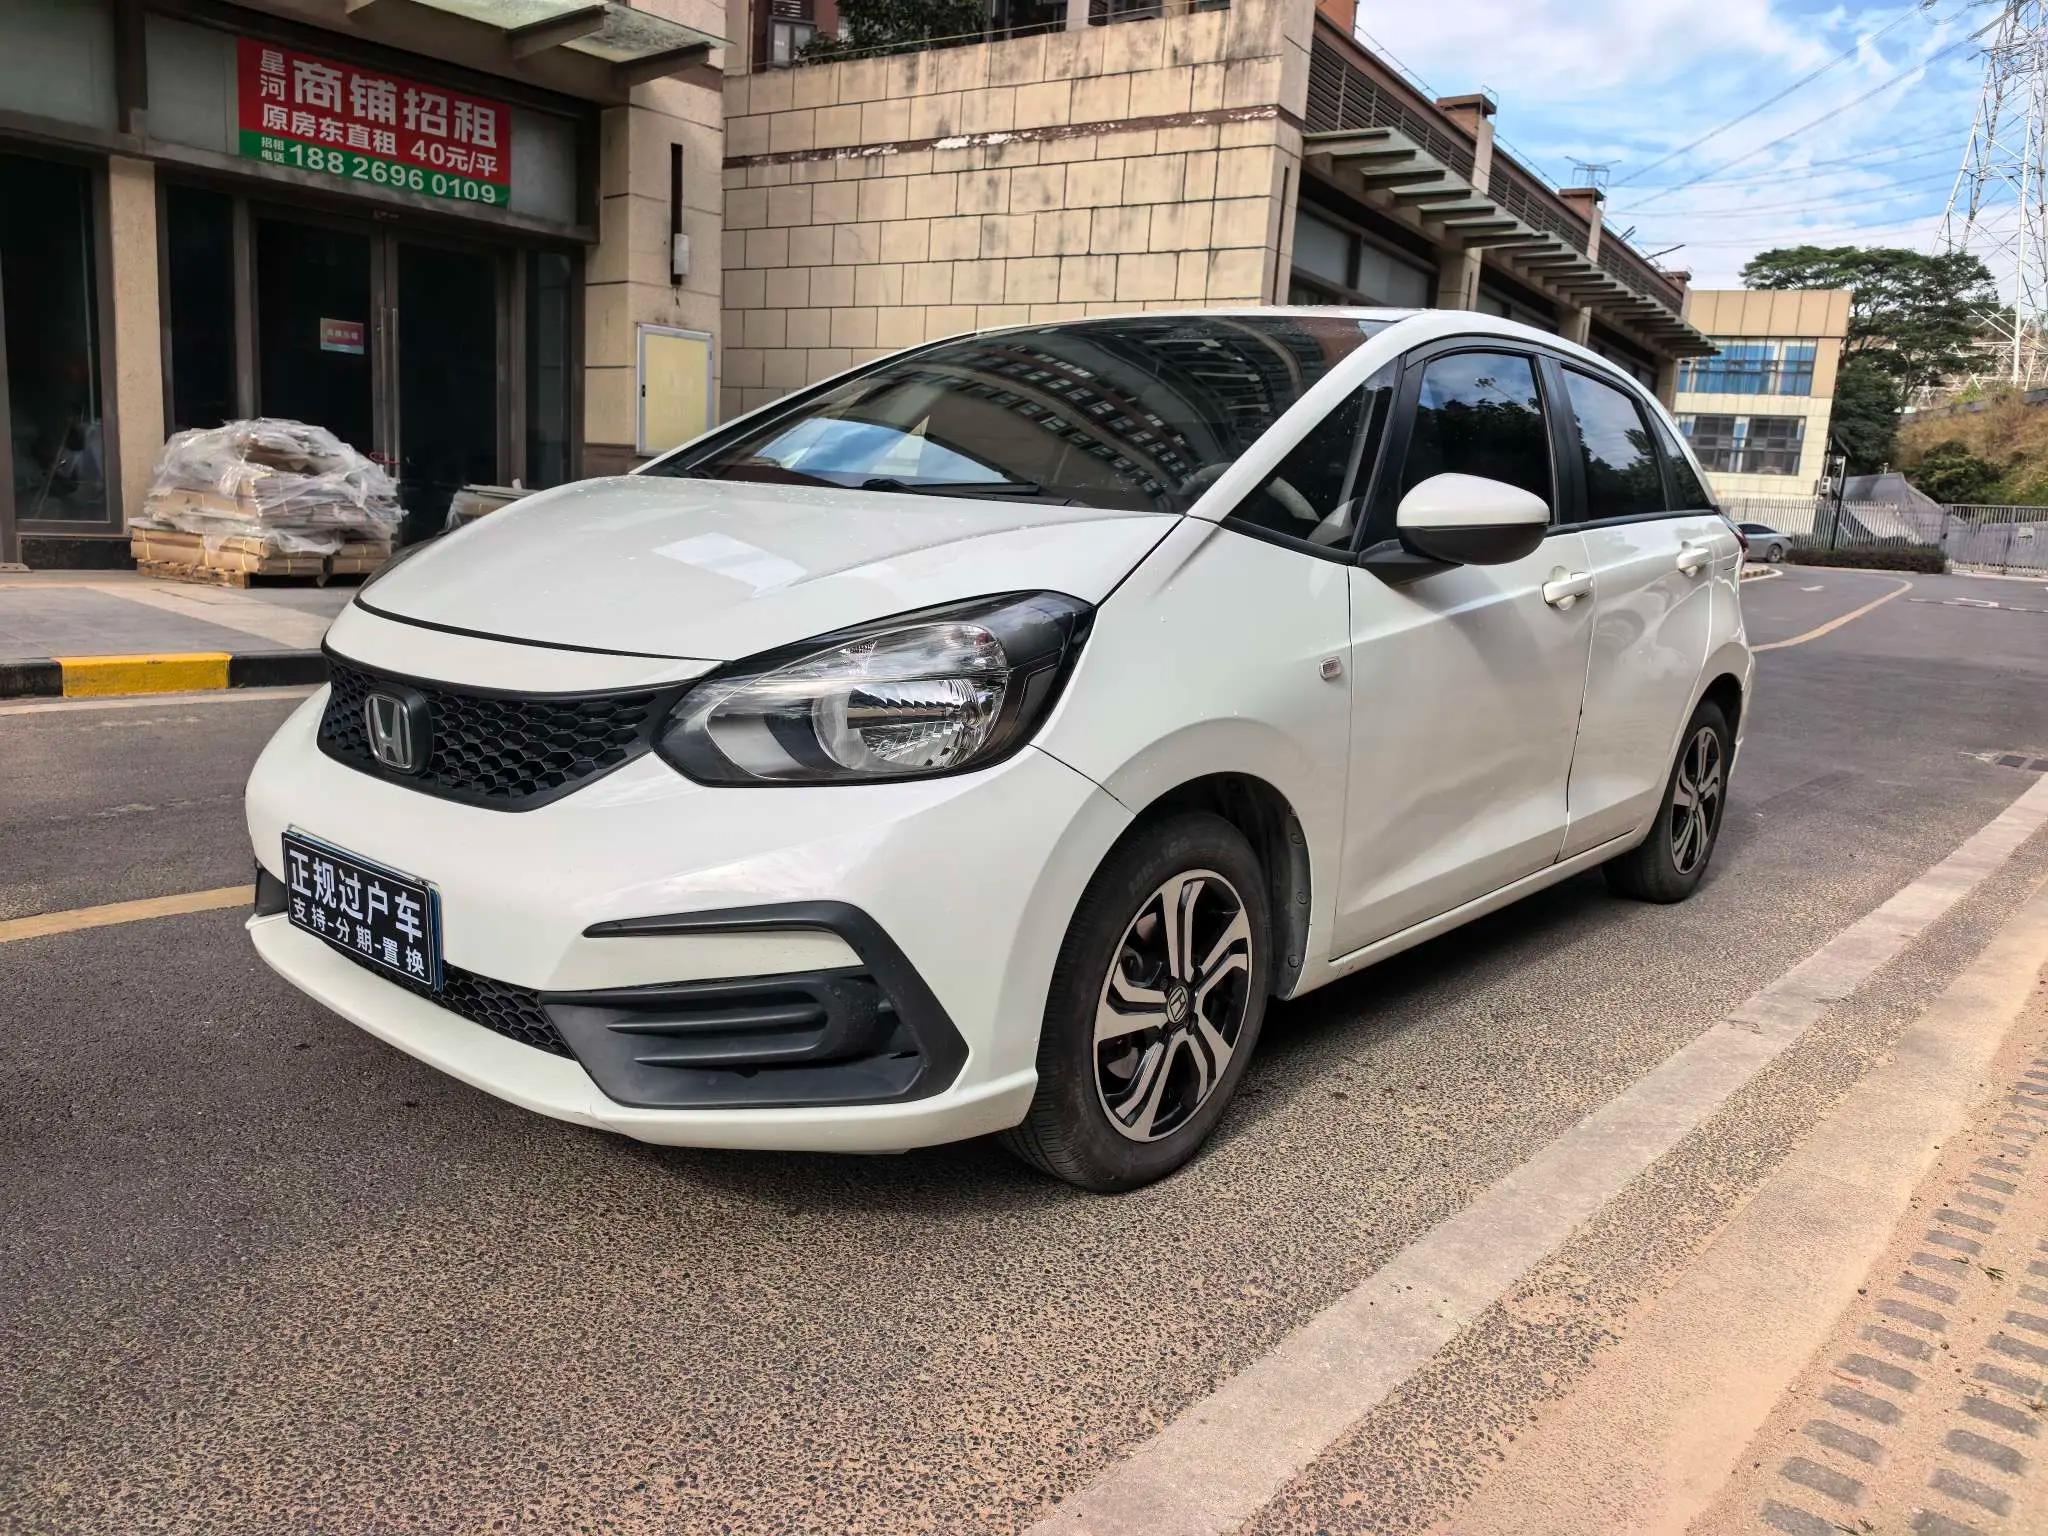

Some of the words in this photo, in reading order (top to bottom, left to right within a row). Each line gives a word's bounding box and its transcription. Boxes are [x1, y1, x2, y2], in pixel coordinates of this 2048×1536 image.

[260, 48, 287, 101] 星河
[292, 58, 497, 149] 商铺招租
[262, 103, 398, 157] 原房东直租
[410, 139, 498, 177] 40元/平
[289, 144, 345, 175] 188
[352, 156, 424, 191] 2696
[431, 173, 497, 204] 0109
[289, 849, 423, 944] 正规过户车
